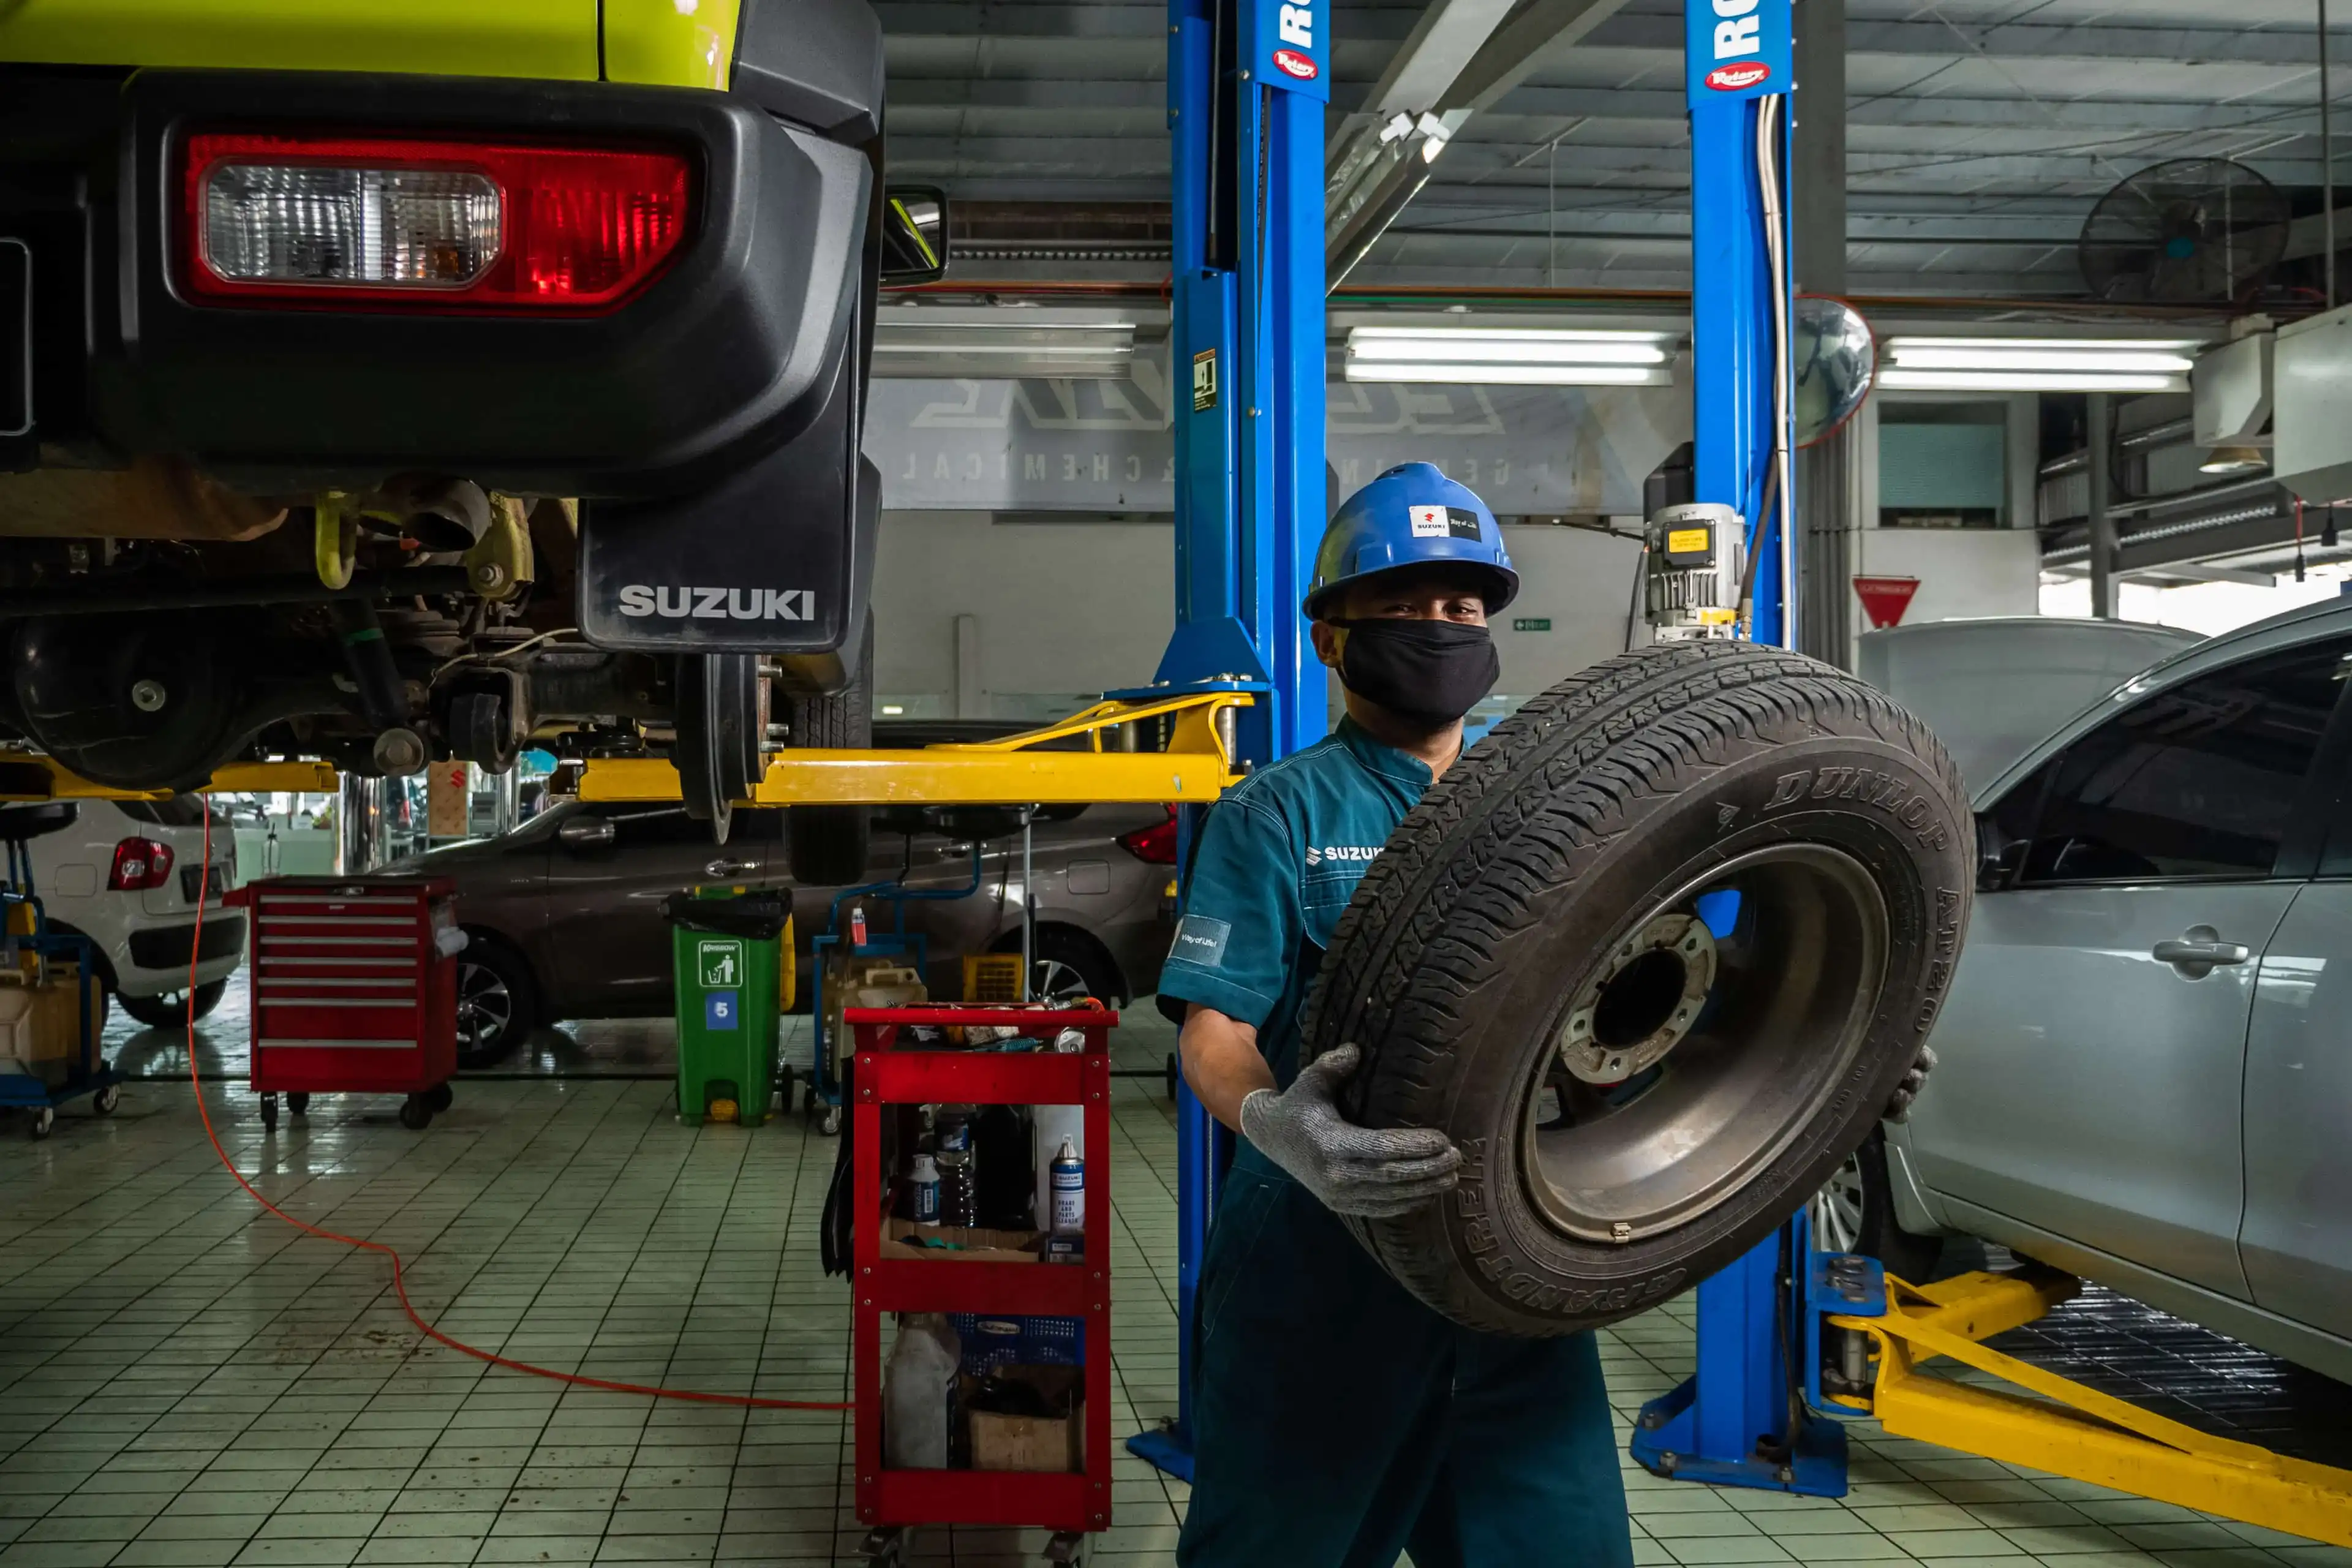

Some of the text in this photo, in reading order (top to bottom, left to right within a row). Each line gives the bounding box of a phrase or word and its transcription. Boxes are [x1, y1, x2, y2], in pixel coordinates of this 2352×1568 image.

[619, 585, 815, 622] SUZUKI
[1763, 766, 1950, 853] DUNLOP
[714, 1001, 728, 1017] 5
